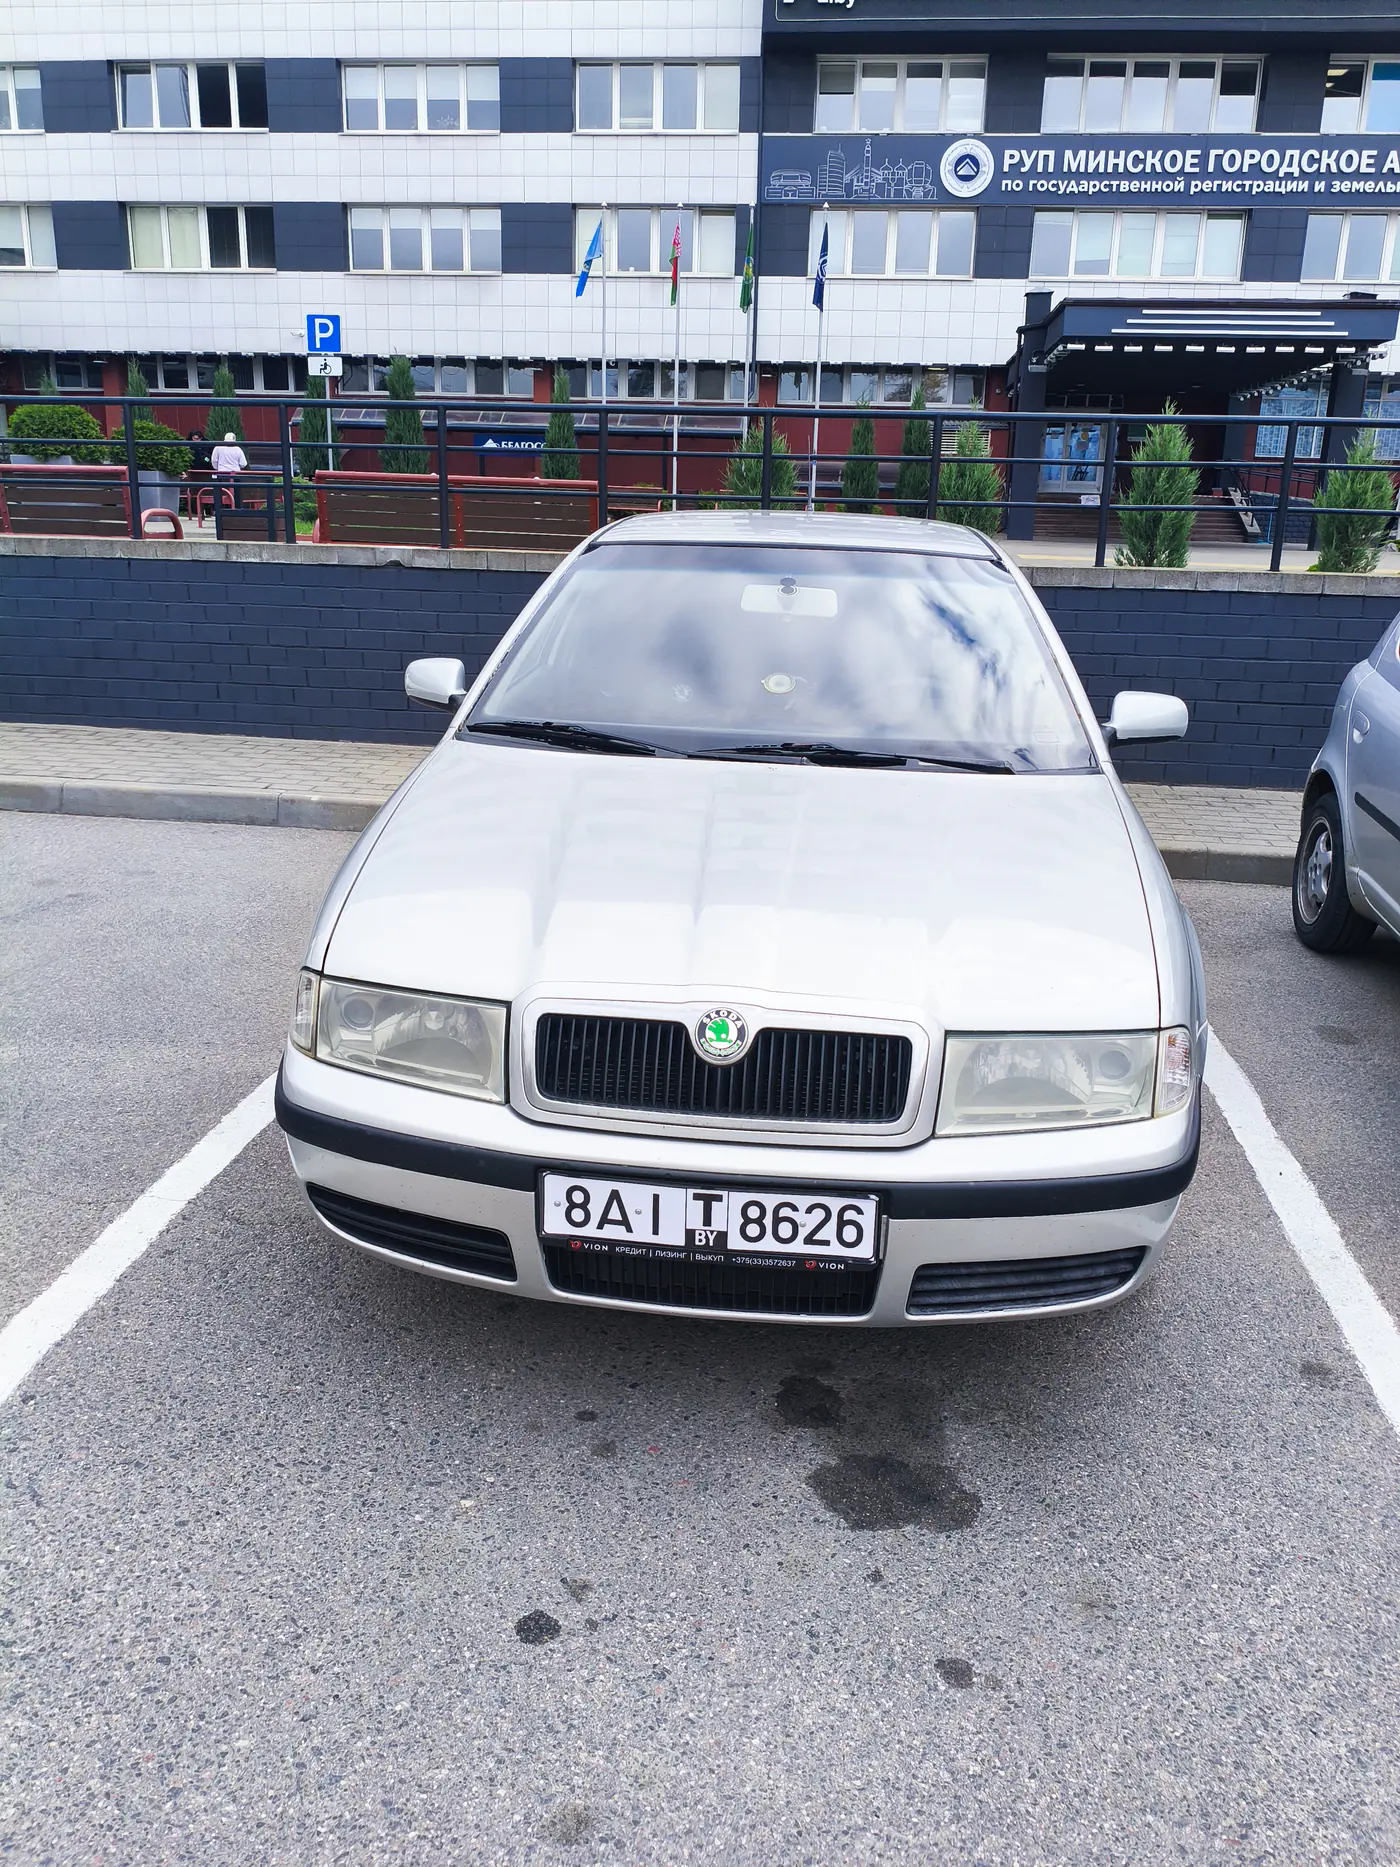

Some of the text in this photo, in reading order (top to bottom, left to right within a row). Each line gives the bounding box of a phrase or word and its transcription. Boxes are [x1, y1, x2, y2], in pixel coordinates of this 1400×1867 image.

[1003, 149, 1055, 173] РУП
[1063, 149, 1202, 173] МИНСКОЕ
[1207, 149, 1378, 177] ГОРОДСКОЕ
[1001, 179, 1024, 191] по
[1028, 176, 1185, 195] государственной
[1190, 180, 1309, 195] регистрации
[1314, 181, 1326, 192] и
[314, 318, 334, 349] P
[702, 1010, 743, 1029] SKODA
[692, 1192, 724, 1228] T
[739, 1200, 865, 1249] 8626
[694, 1230, 718, 1247] BY
[583, 1243, 845, 1270] VION КРЕДИТ ЛИЗИНГ ВЫКУП +375(33)3572637 VION
